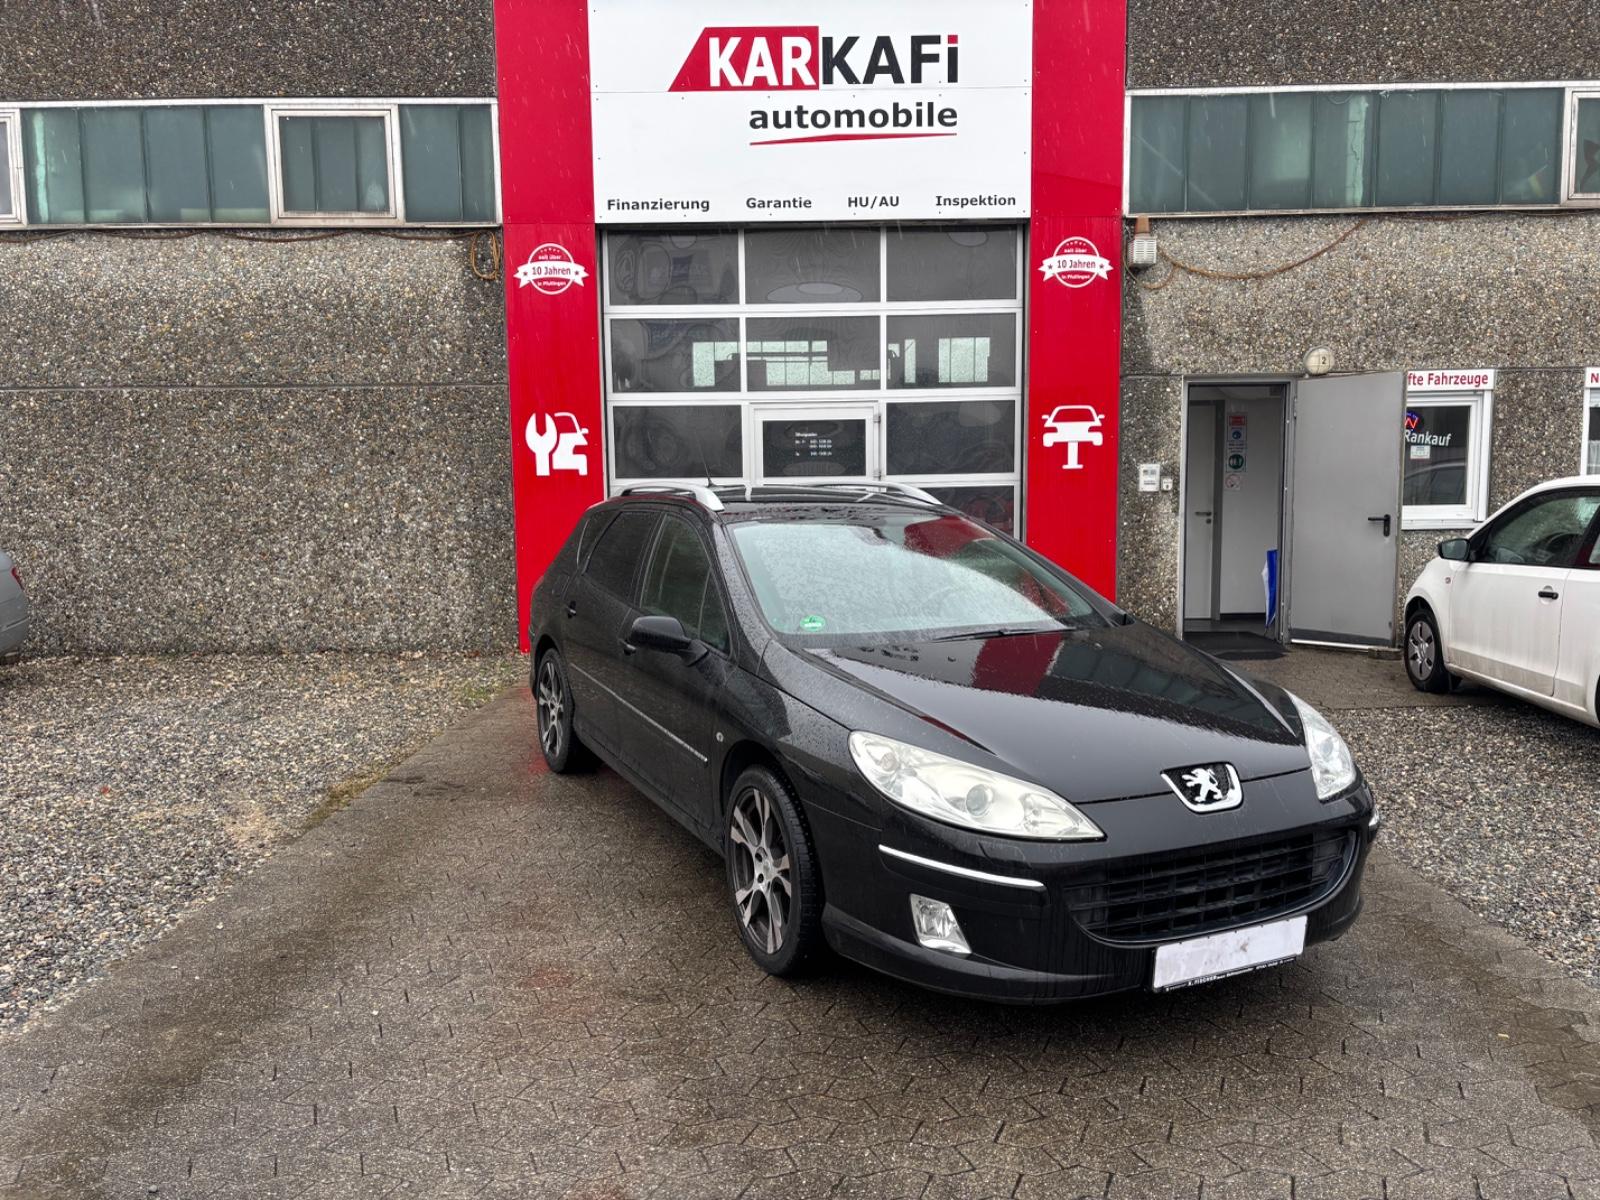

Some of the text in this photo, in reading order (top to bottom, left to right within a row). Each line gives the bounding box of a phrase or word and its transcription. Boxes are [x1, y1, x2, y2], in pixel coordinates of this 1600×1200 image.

[749, 102, 958, 129] automobile
[607, 195, 1016, 212] Finanzierung Garantie HU/AU Inspektion
[532, 265, 571, 276] 10 Jahren
[1057, 259, 1096, 269] 10 Jahren
[1427, 372, 1489, 387] Fahrzeuge
